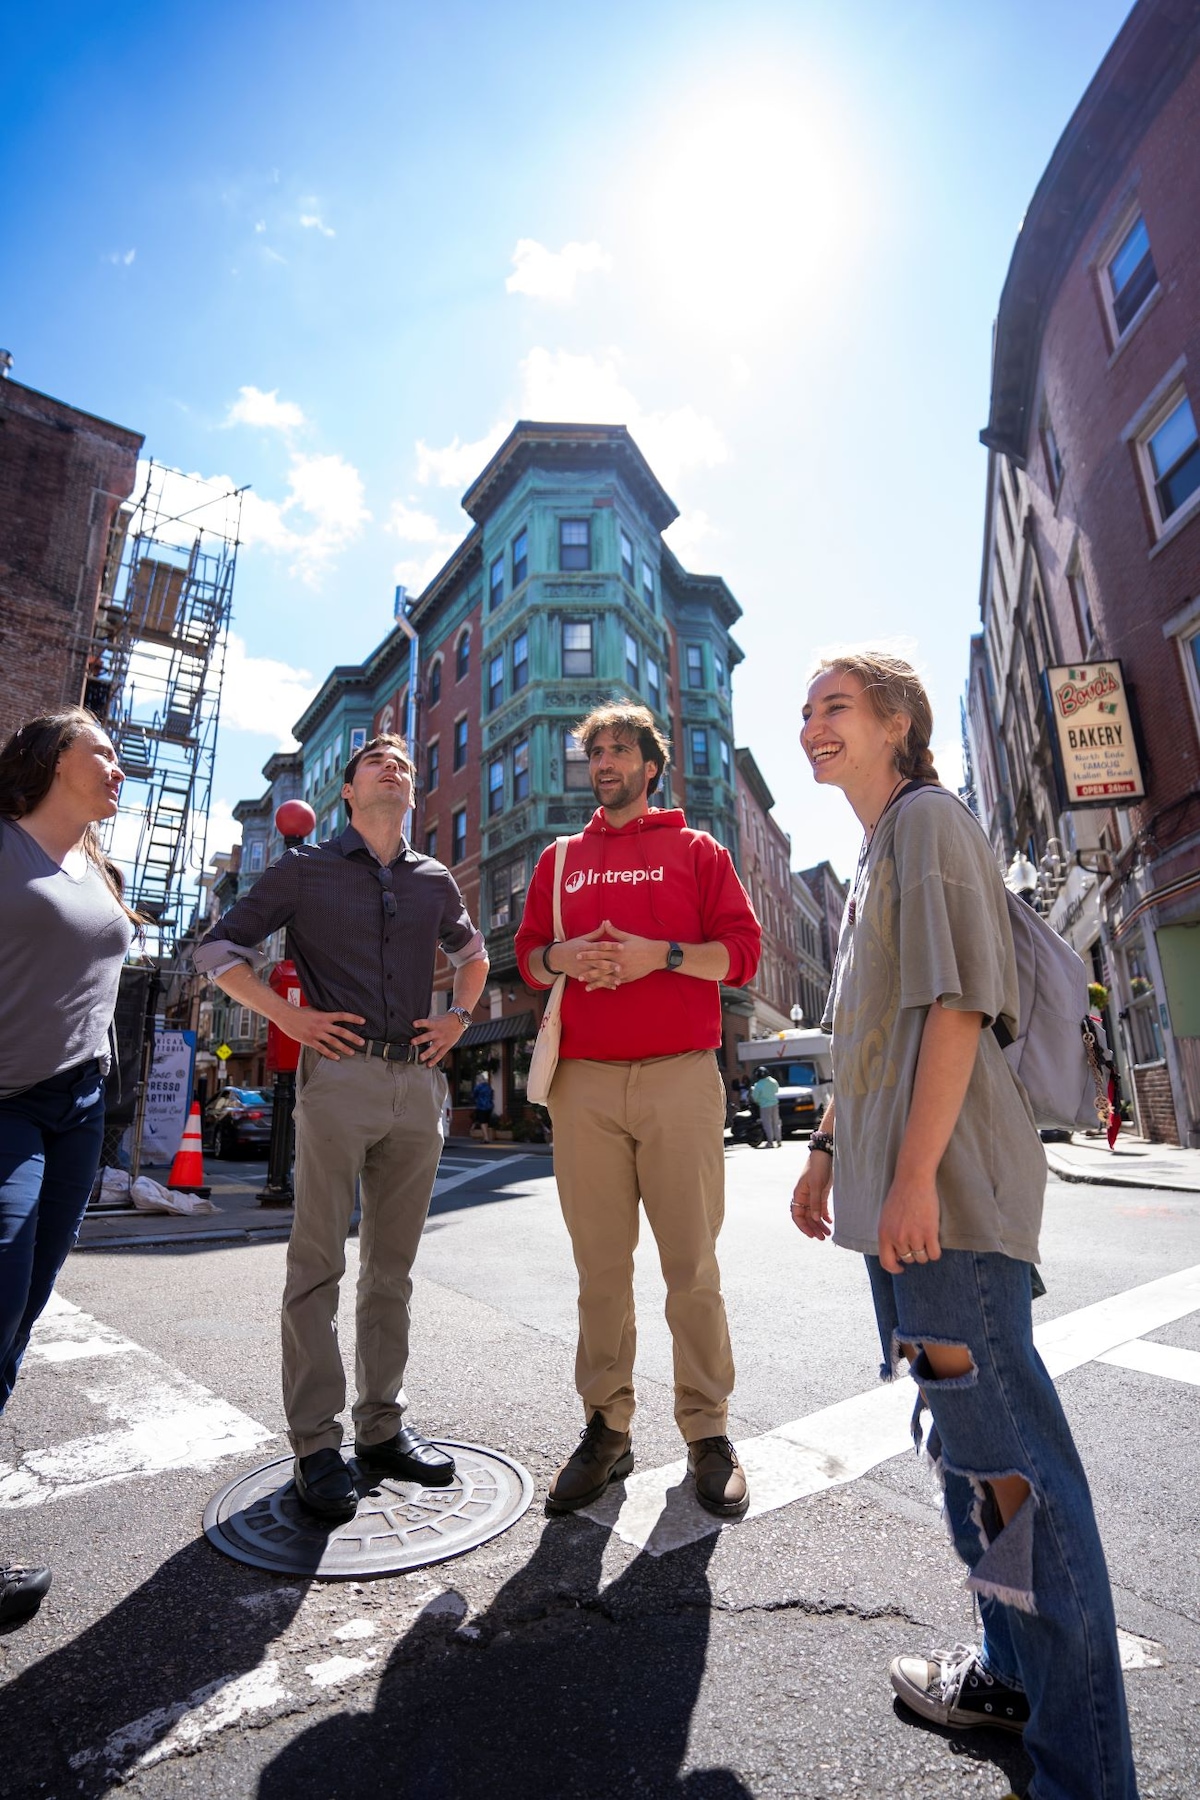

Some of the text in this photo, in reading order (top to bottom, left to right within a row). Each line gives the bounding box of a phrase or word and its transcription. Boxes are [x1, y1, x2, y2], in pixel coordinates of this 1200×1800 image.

[1056, 667, 1119, 718] Bova's
[1068, 725, 1122, 748] BAKERY
[1075, 753, 1100, 761] North
[1073, 768, 1133, 780] Italian Bread
[1082, 783, 1131, 795] OPEN 24hrs
[586, 865, 664, 886] Intrepid
